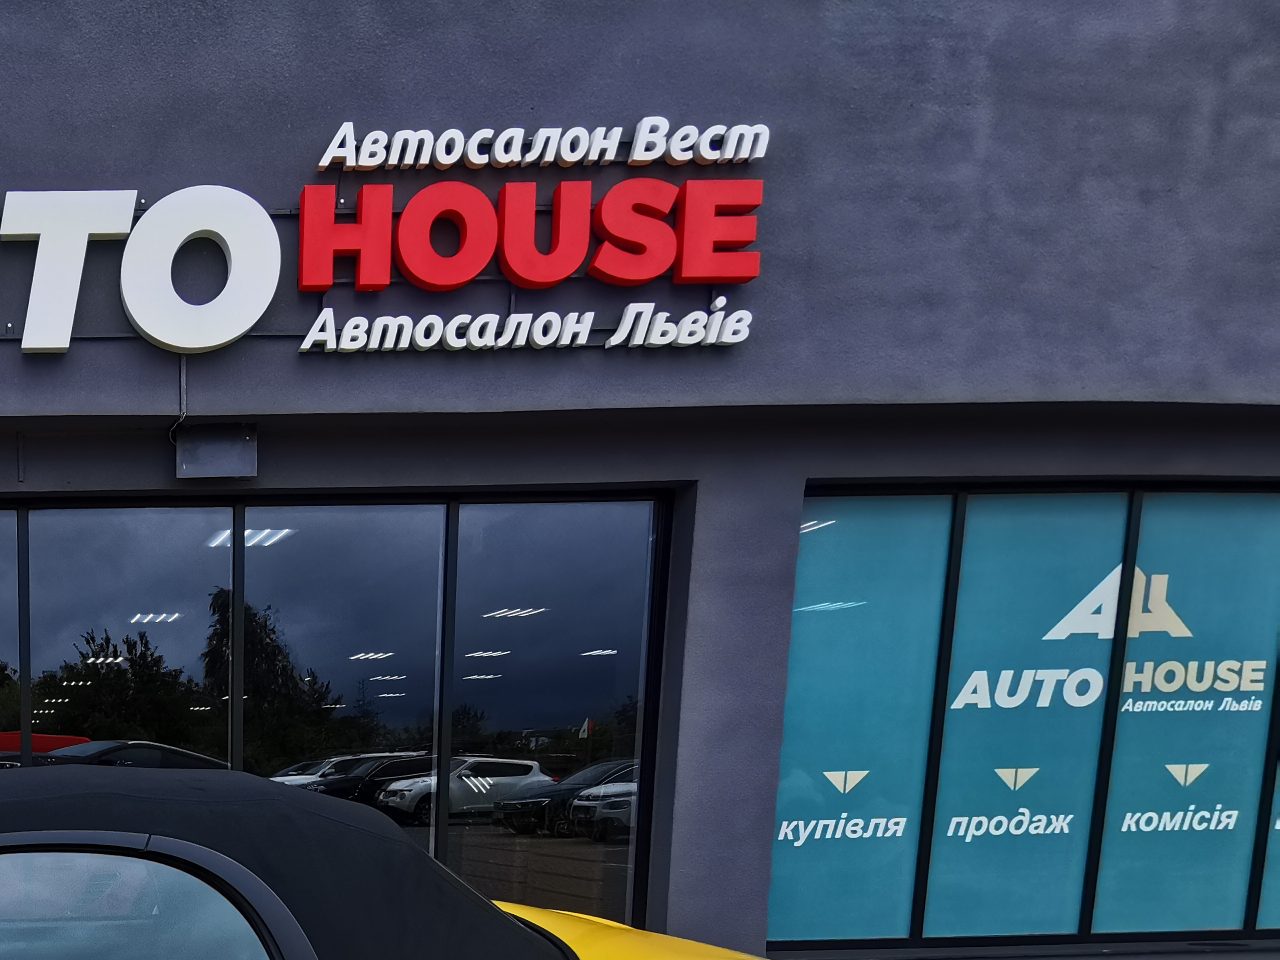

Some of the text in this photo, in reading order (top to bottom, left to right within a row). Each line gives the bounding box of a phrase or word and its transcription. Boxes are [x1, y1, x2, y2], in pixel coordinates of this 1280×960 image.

[319, 116, 770, 171] Автосалон Вест
[298, 177, 764, 292] HOUSE
[298, 295, 753, 354] Автосалон Львів
[951, 660, 1268, 709] AUTO HOUSE
[1121, 695, 1263, 712] Автосалон Львів
[777, 812, 908, 847] купівля
[946, 808, 1074, 843] продаж
[1121, 804, 1239, 832] комісія
